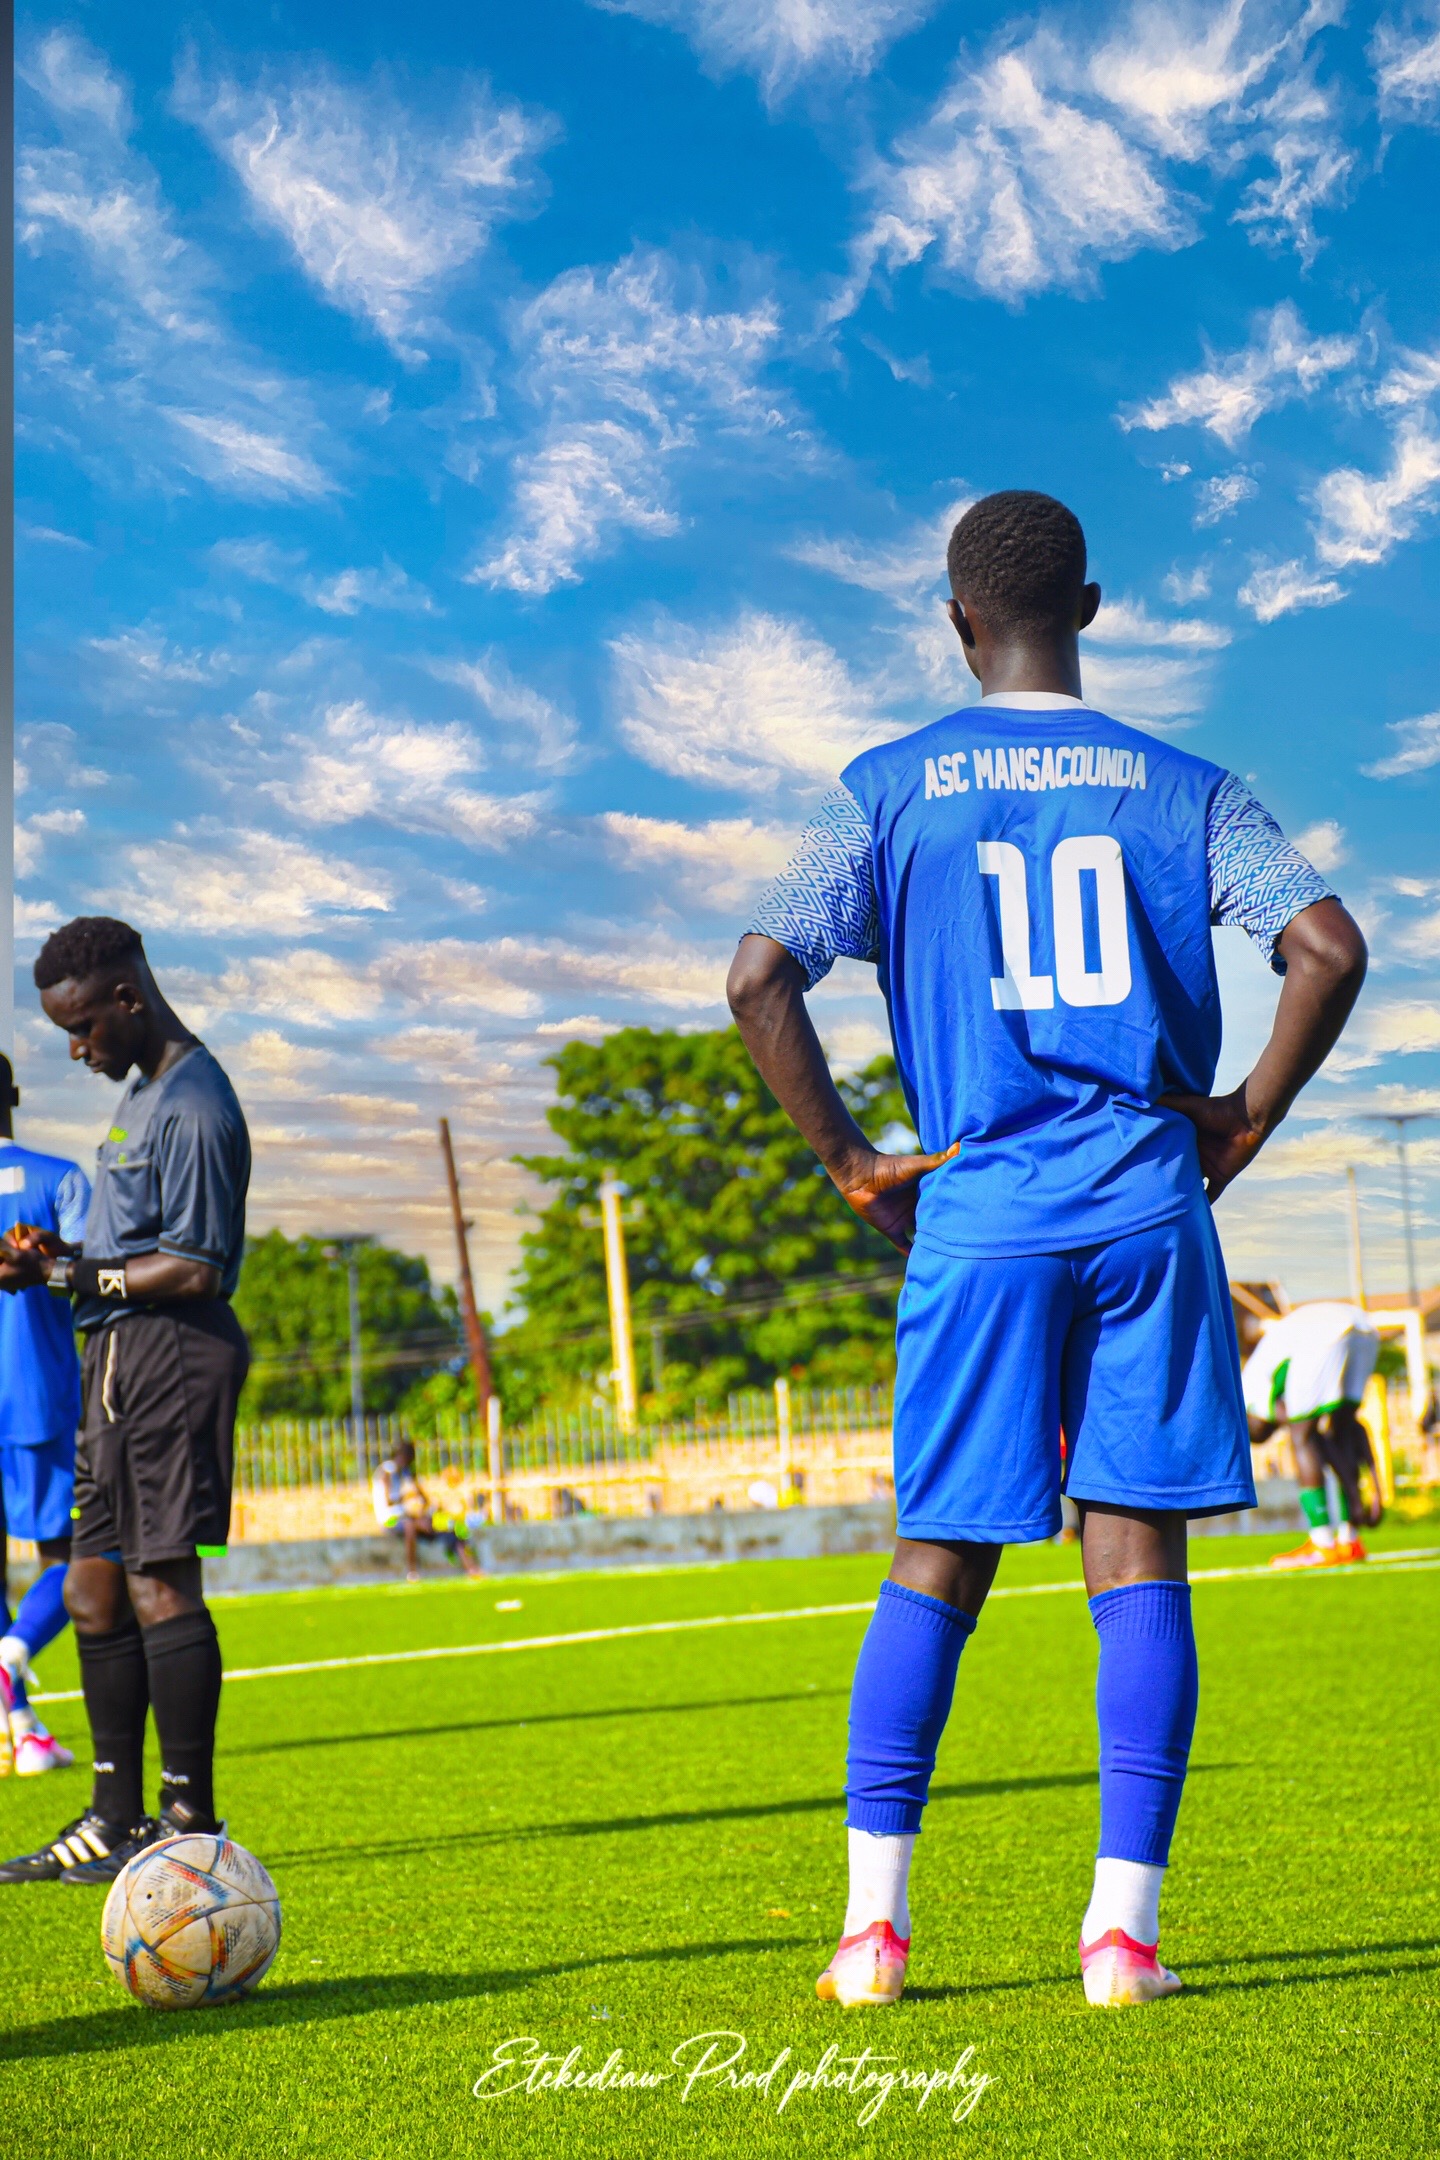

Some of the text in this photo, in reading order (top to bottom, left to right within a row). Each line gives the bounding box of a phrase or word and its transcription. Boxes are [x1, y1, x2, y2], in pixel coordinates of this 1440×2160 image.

[924, 746, 1147, 800] ASC MANSACOUNDA
[976, 835, 1132, 1011] 10
